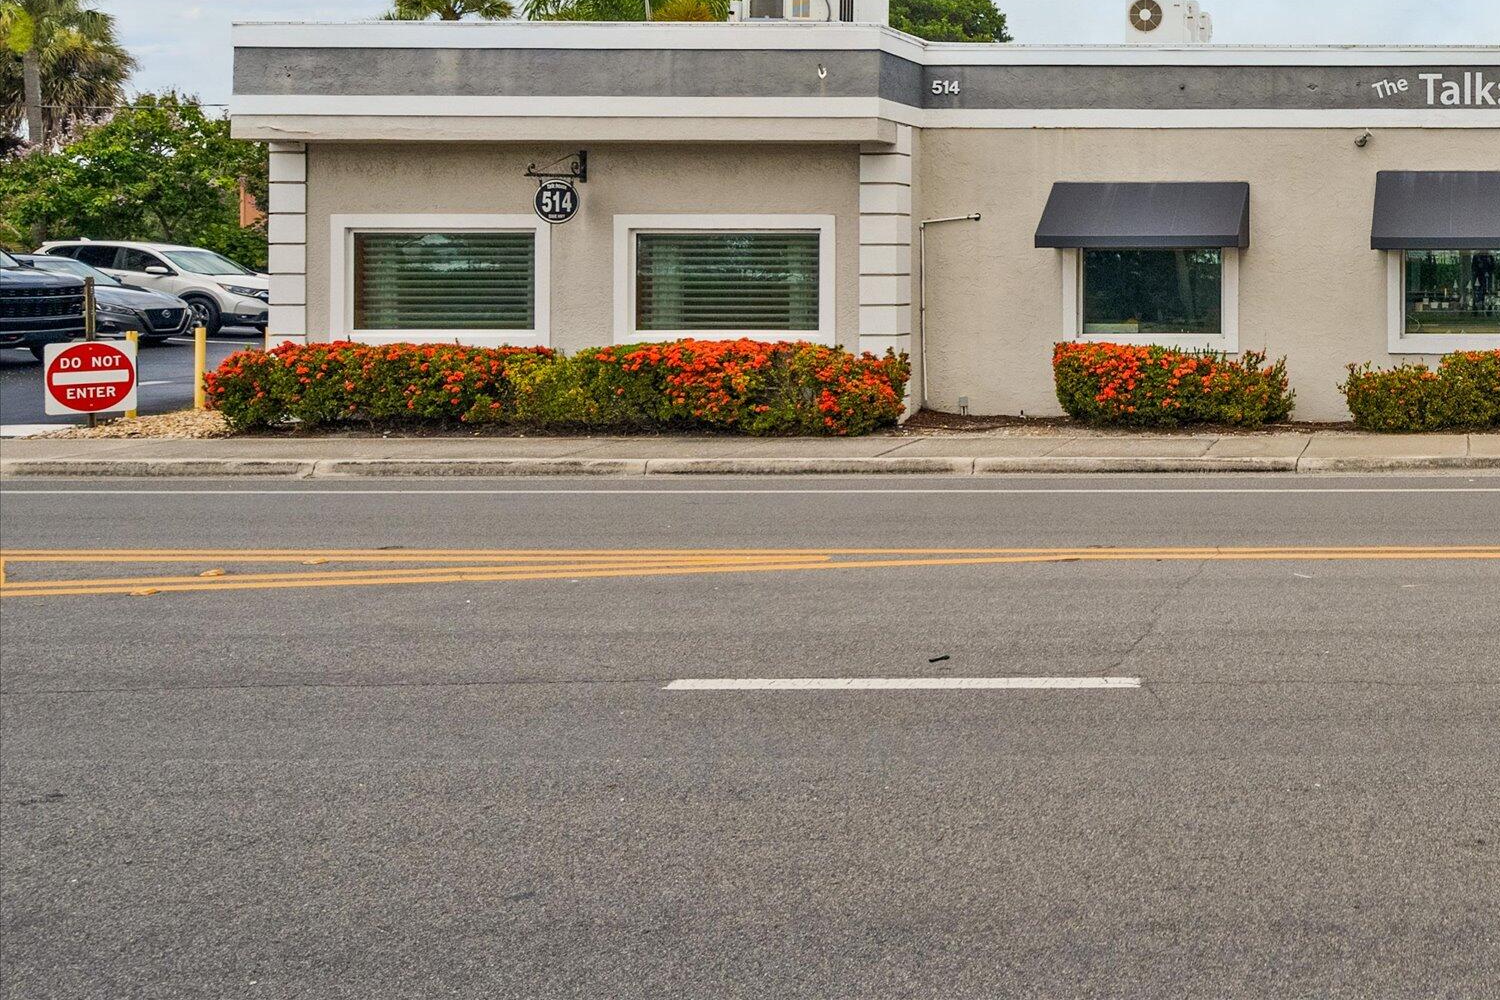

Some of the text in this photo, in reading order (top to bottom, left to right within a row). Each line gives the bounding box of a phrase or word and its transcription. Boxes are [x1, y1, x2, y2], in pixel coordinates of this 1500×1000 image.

[931, 80, 960, 95] 514
[1371, 77, 1409, 99] The
[541, 191, 573, 213] 514
[59, 355, 122, 369] DO NOT
[66, 386, 117, 400] ENTER
